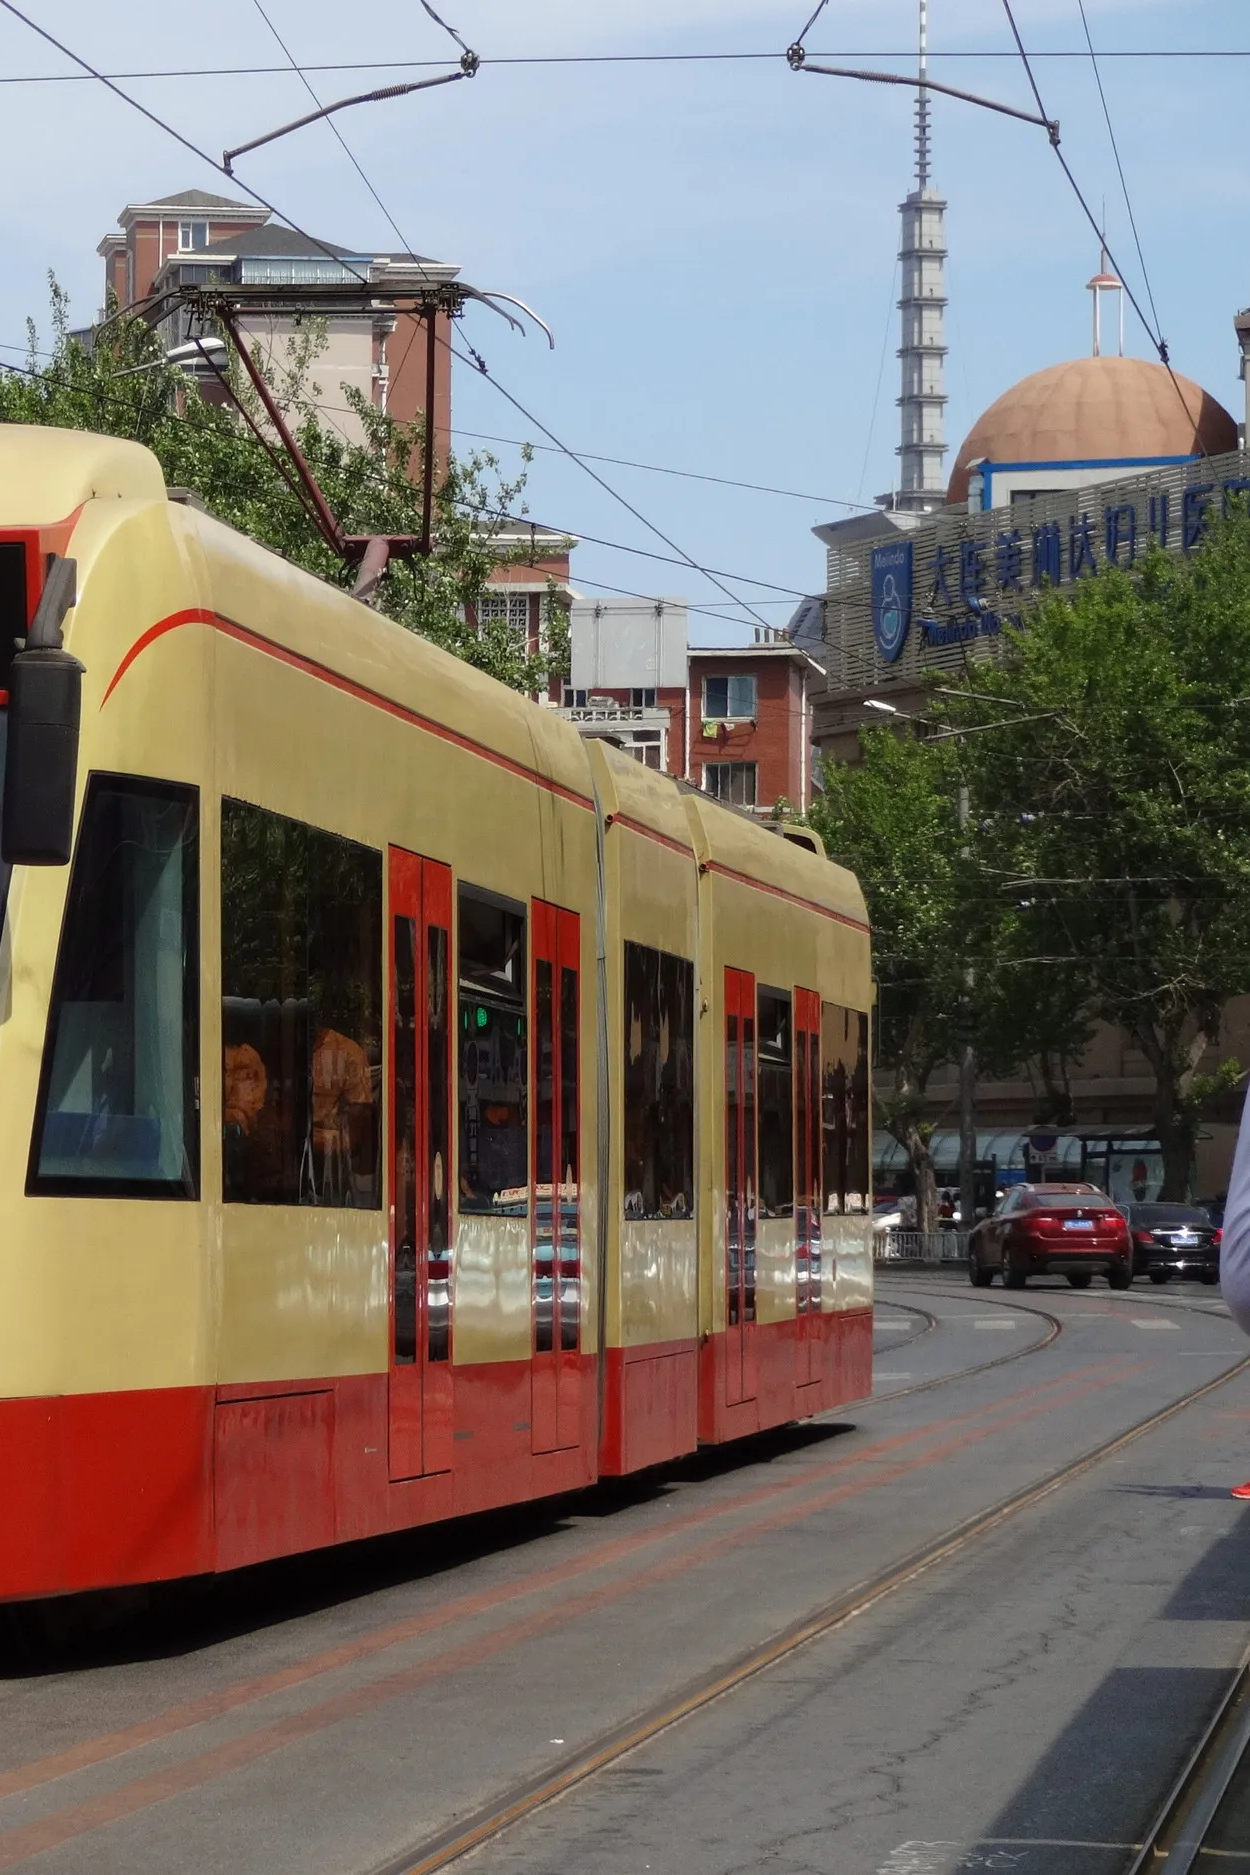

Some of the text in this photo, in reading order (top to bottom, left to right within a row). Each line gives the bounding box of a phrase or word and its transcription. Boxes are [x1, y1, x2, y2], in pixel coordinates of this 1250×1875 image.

[927, 477, 1250, 605] 大连美琳达妇儿医
